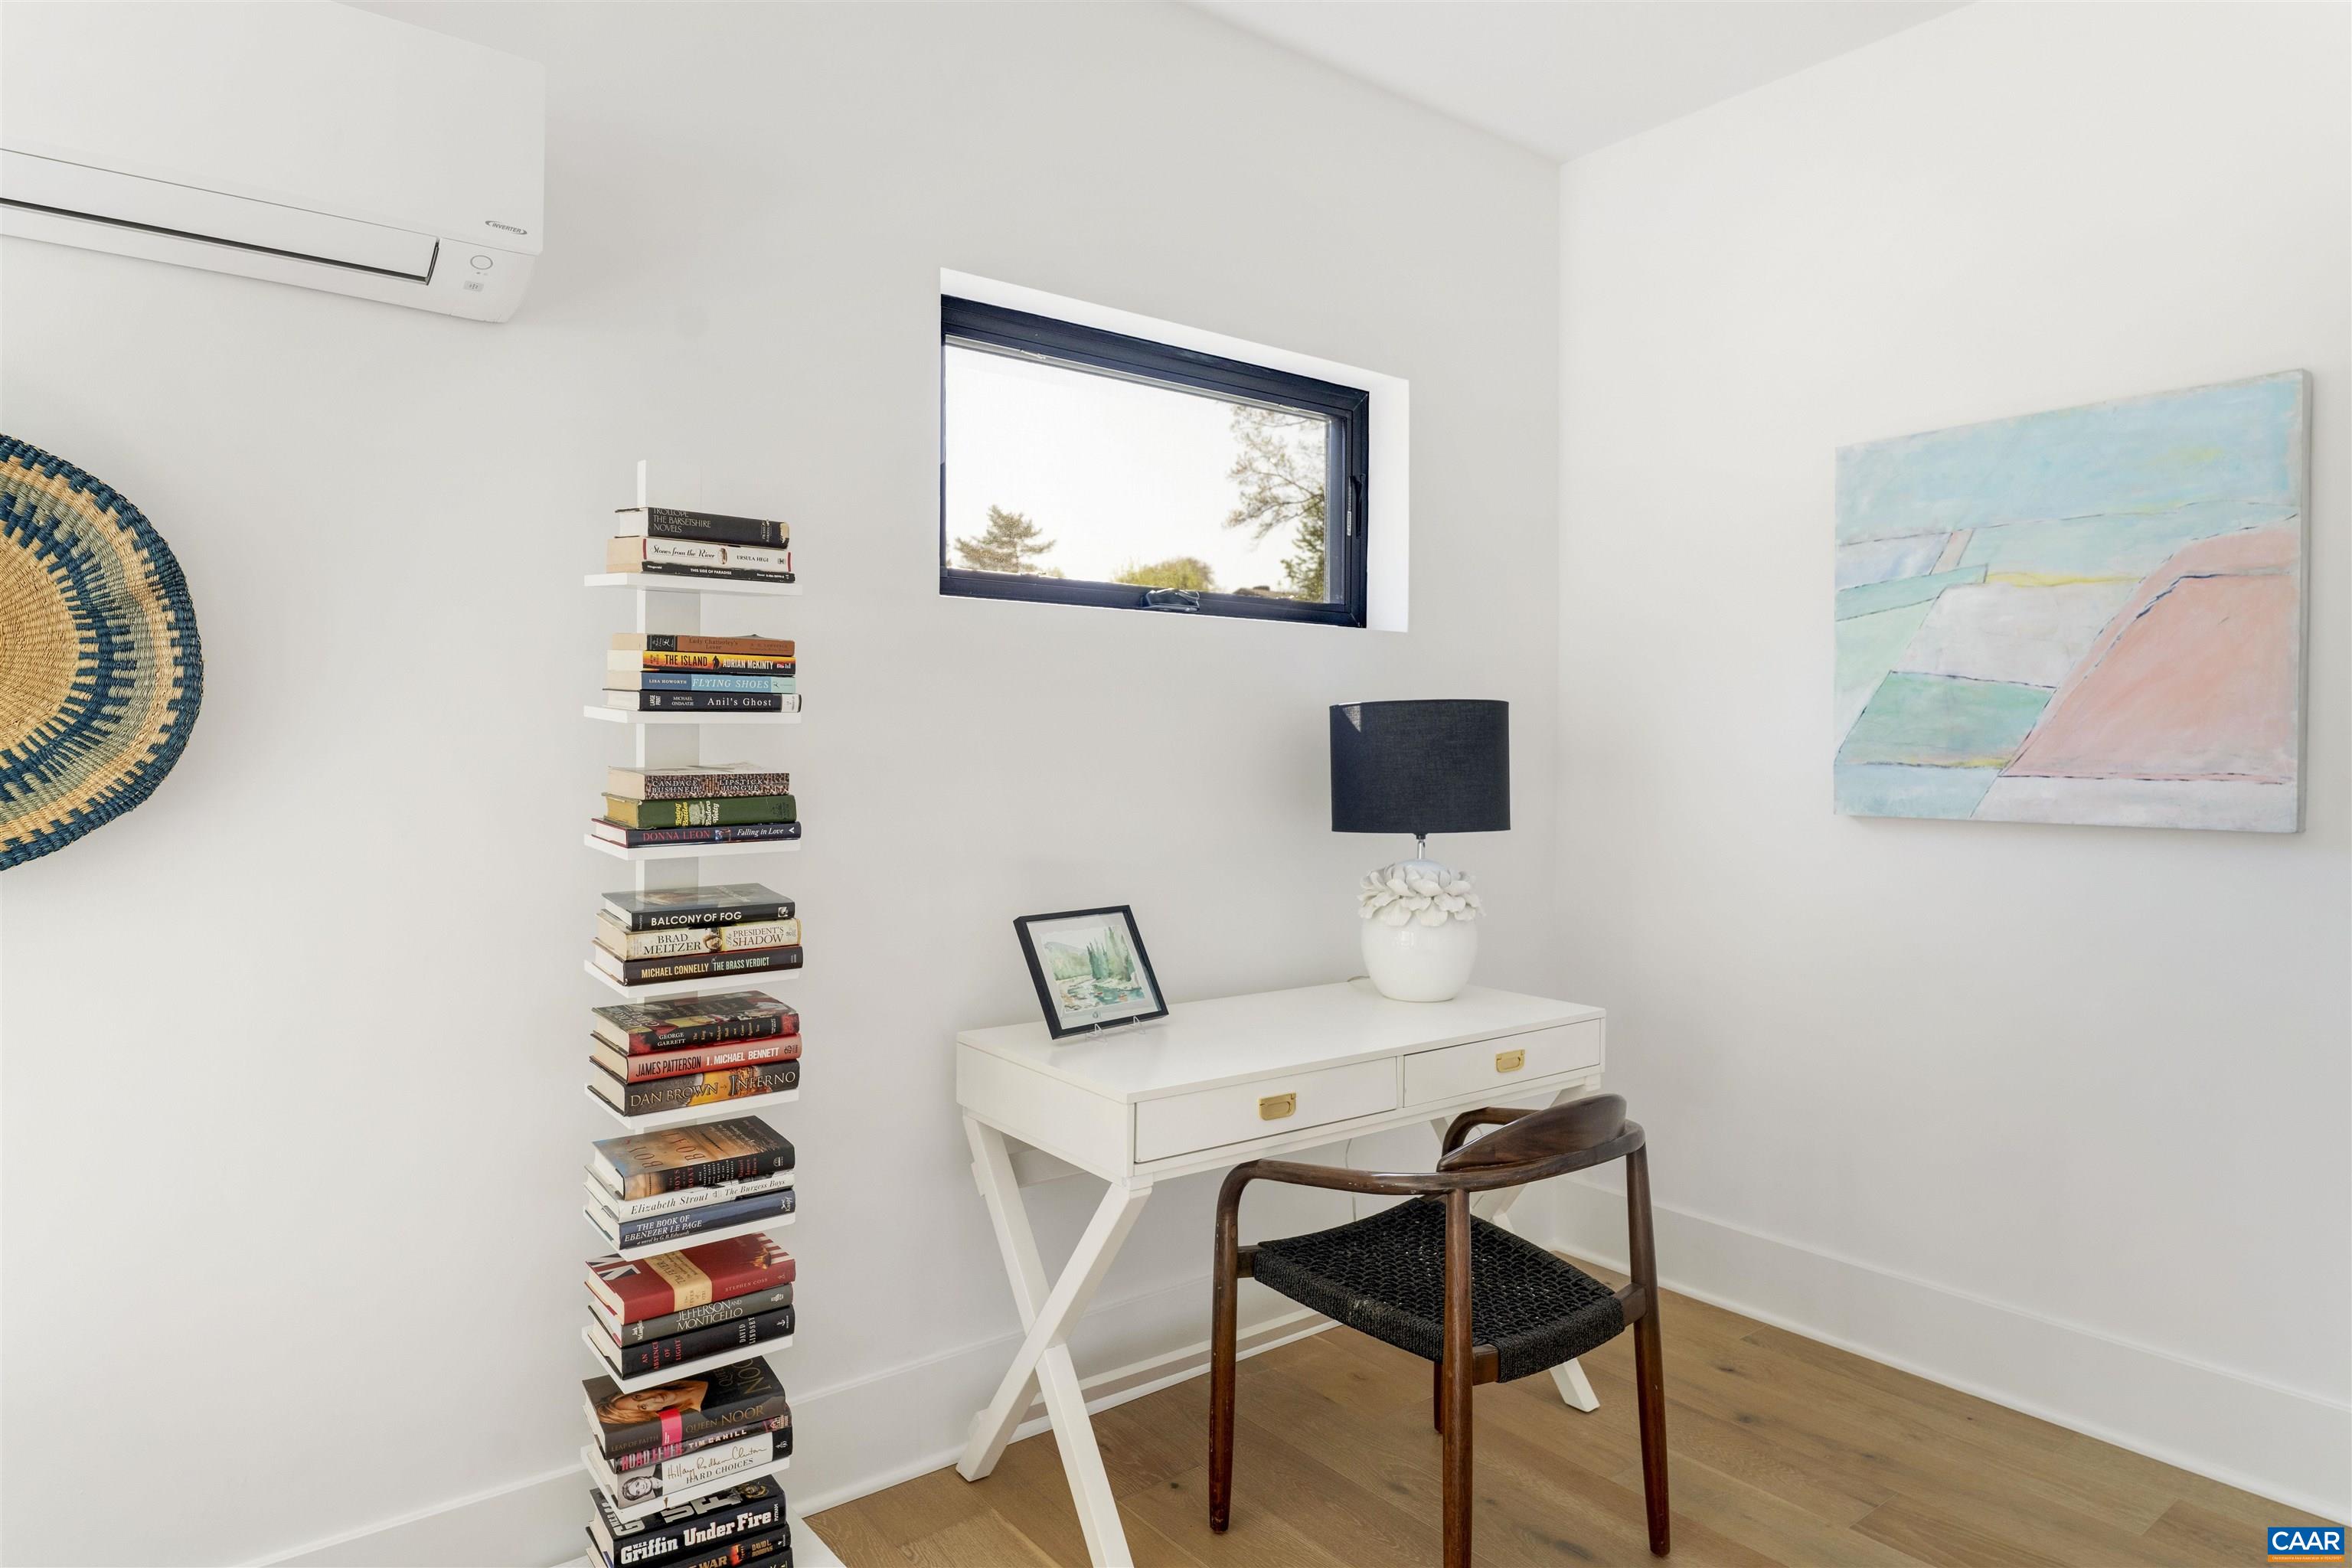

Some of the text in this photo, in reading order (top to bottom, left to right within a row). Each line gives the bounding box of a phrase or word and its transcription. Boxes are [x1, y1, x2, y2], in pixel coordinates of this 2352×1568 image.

[492, 222, 521, 234] INVERTER
[653, 515, 711, 528] THE BARSETSHIRE
[654, 524, 681, 533] NOVELS
[654, 544, 671, 554] Stones
[672, 547, 685, 556] from
[698, 549, 715, 558] River
[705, 637, 738, 645] Chatterley's
[665, 655, 678, 665] THE
[681, 655, 707, 666] ISLAND
[723, 658, 773, 670] ADRIAN McKINTY
[692, 678, 769, 688] FLYING SHOES
[707, 697, 771, 706] Anil's Ghost
[711, 803, 720, 824] Welty
[643, 830, 710, 841] DONNA LEON
[737, 828, 759, 837] Falling
[651, 914, 702, 926] BALCONY
[704, 913, 717, 923] OF
[720, 911, 742, 921] FOG
[733, 926, 784, 937] PRESIDENT'S
[658, 934, 688, 944] BRAD
[733, 934, 784, 946] SHADOW
[643, 941, 701, 955] MELTZER
[642, 963, 709, 978] MICHAEL CONNELLY
[713, 956, 769, 972] THE BRASS VERDICT
[657, 1038, 686, 1047] GARRETT
[714, 1052, 746, 1065] MICHAEL
[748, 1047, 779, 1060] BENNETT
[635, 1056, 701, 1077] JAMES PATTERSON
[729, 1071, 795, 1096] INFERNO
[631, 1082, 718, 1107] DAN BROWN
[740, 1182, 767, 1194] Burgess
[631, 1193, 708, 1215] Elizabeth Strout
[625, 1220, 702, 1242] EBENEZER LE PAGE
[637, 1222, 654, 1232] THE
[656, 1217, 678, 1227] BOOK
[725, 1282, 751, 1292] STEPHEN
[676, 1300, 731, 1322] JEFFERSON
[677, 1308, 743, 1331] MONTICELLO
[748, 1317, 756, 1344] LINDSEY
[642, 1354, 648, 1364] AN
[664, 1348, 671, 1357] OF
[686, 1419, 717, 1433] QUEEN
[721, 1405, 765, 1426] NOOR
[708, 1429, 746, 1443] CAHILL
[612, 1443, 627, 1452] LEAP
[639, 1435, 658, 1445] FAITH
[668, 1446, 767, 1481] Hillary Rodham Clinton
[686, 1458, 753, 1484] HARD CHOICES
[621, 1511, 772, 1564] Griffin Under Fire
[752, 1540, 766, 1551] DAVID
[698, 1555, 727, 1568] WAR
